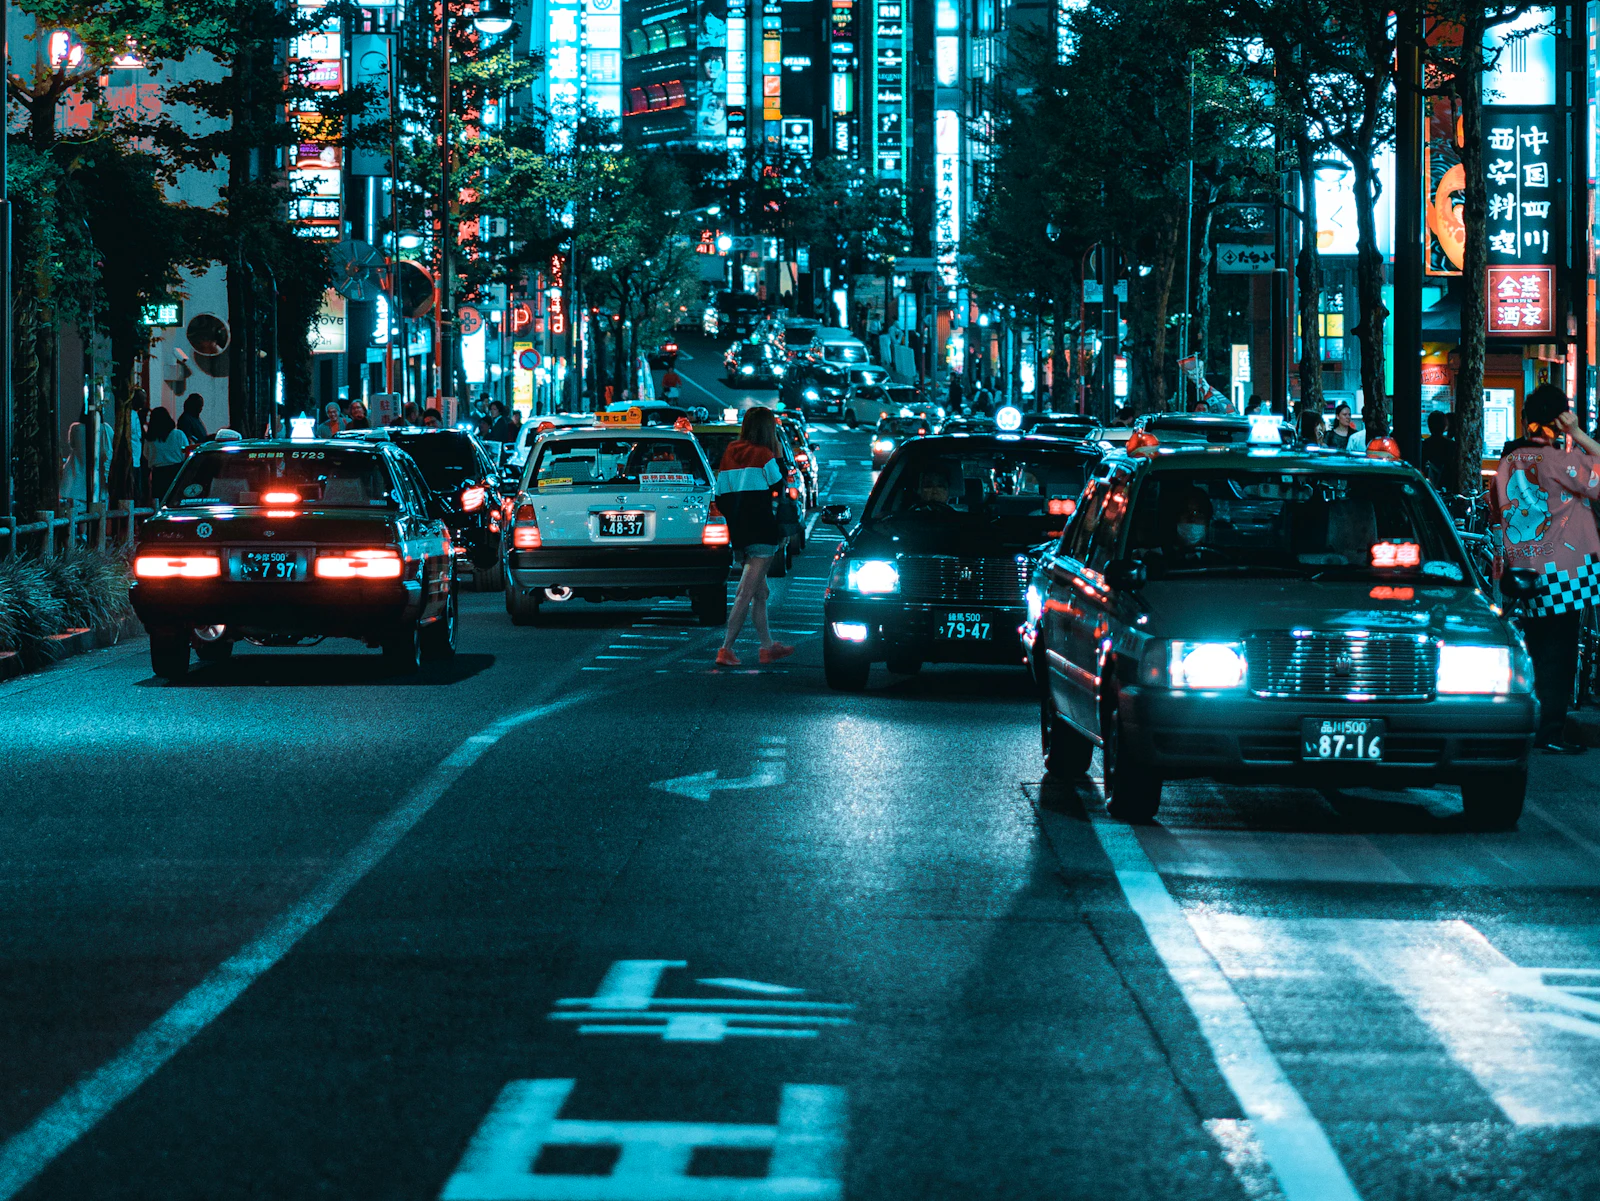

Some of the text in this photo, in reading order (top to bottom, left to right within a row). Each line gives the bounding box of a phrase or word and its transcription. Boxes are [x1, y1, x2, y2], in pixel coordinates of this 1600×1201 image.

[1487, 127, 1516, 255] 西安料理
[1520, 126, 1549, 254] 中国四川
[1497, 302, 1542, 327] 酒家
[291, 451, 325, 459] 5723
[623, 514, 636, 522] 500
[609, 522, 643, 535] 48-37
[270, 553, 286, 562] 500
[1371, 542, 1420, 568] 空車
[965, 612, 981, 622] 500
[946, 622, 990, 639] 79-47
[1321, 721, 1367, 734] 品川 500
[1319, 734, 1381, 758] 87-16
